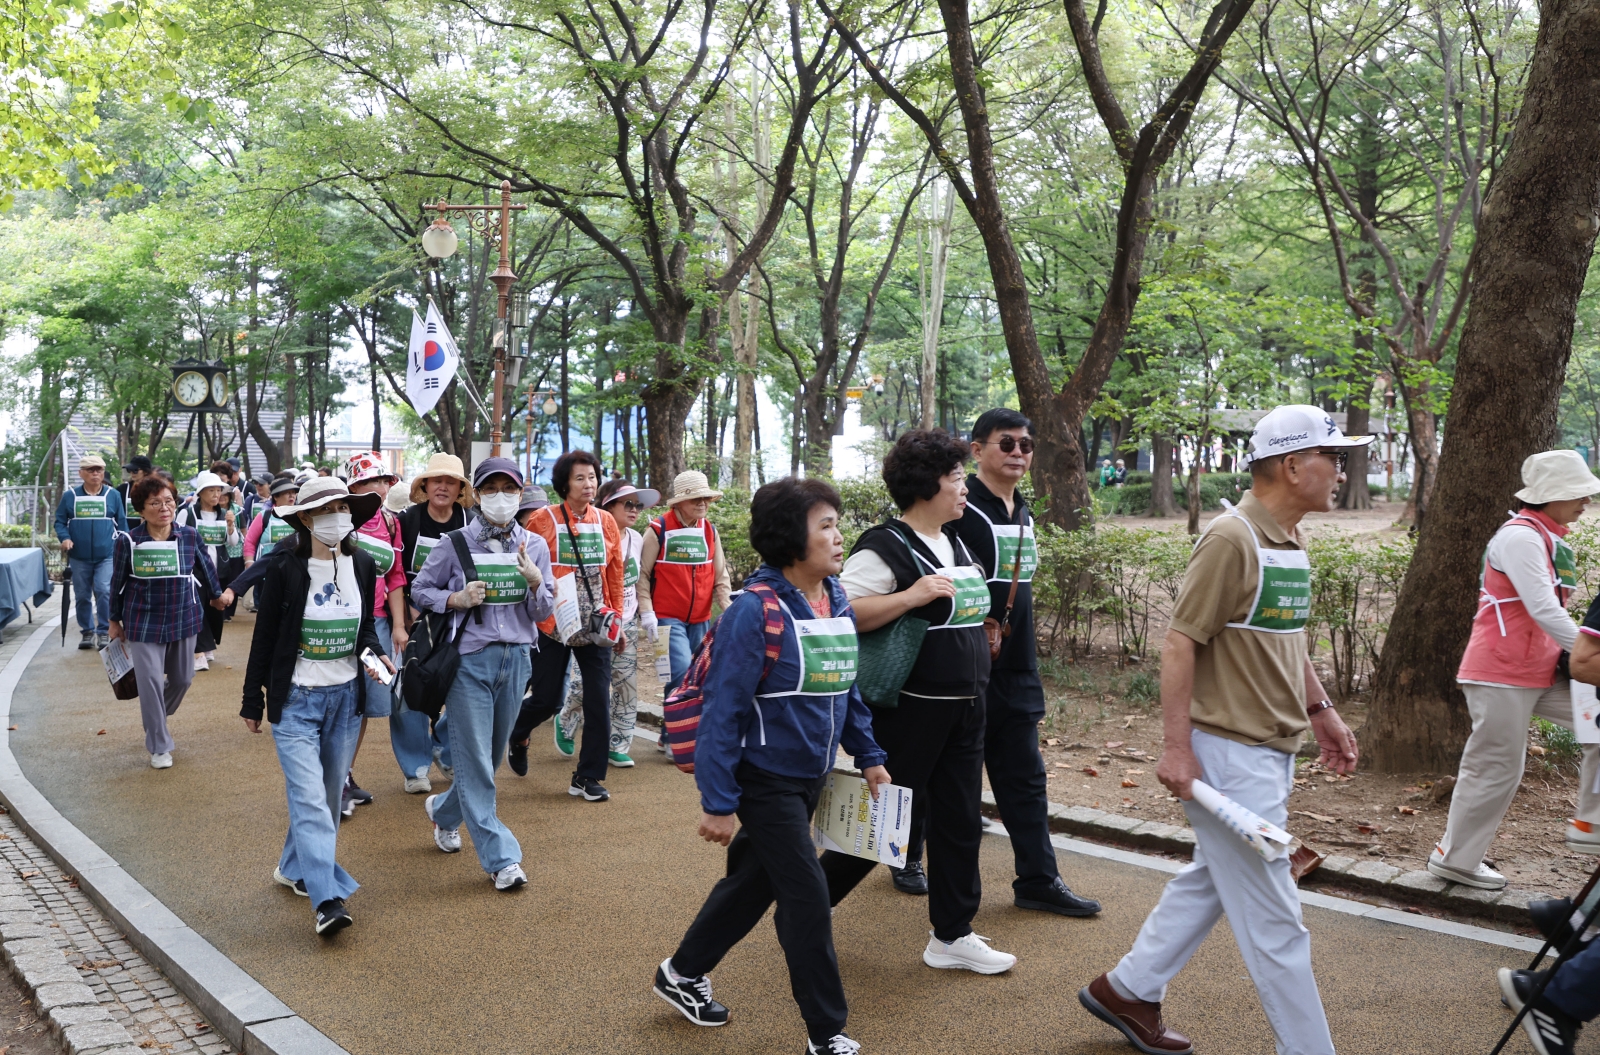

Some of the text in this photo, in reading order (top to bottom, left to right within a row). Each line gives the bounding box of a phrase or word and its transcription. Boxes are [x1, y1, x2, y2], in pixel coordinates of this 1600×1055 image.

[1268, 432, 1309, 447] Cleveland
[495, 580, 515, 588] 시니어
[499, 588, 525, 597] 걷기대회
[1277, 595, 1293, 606] 강남
[308, 637, 346, 645] 강남 시니어
[329, 642, 354, 654] 걷기대회
[821, 660, 837, 670] 강남
[867, 828, 876, 850] 시니어
